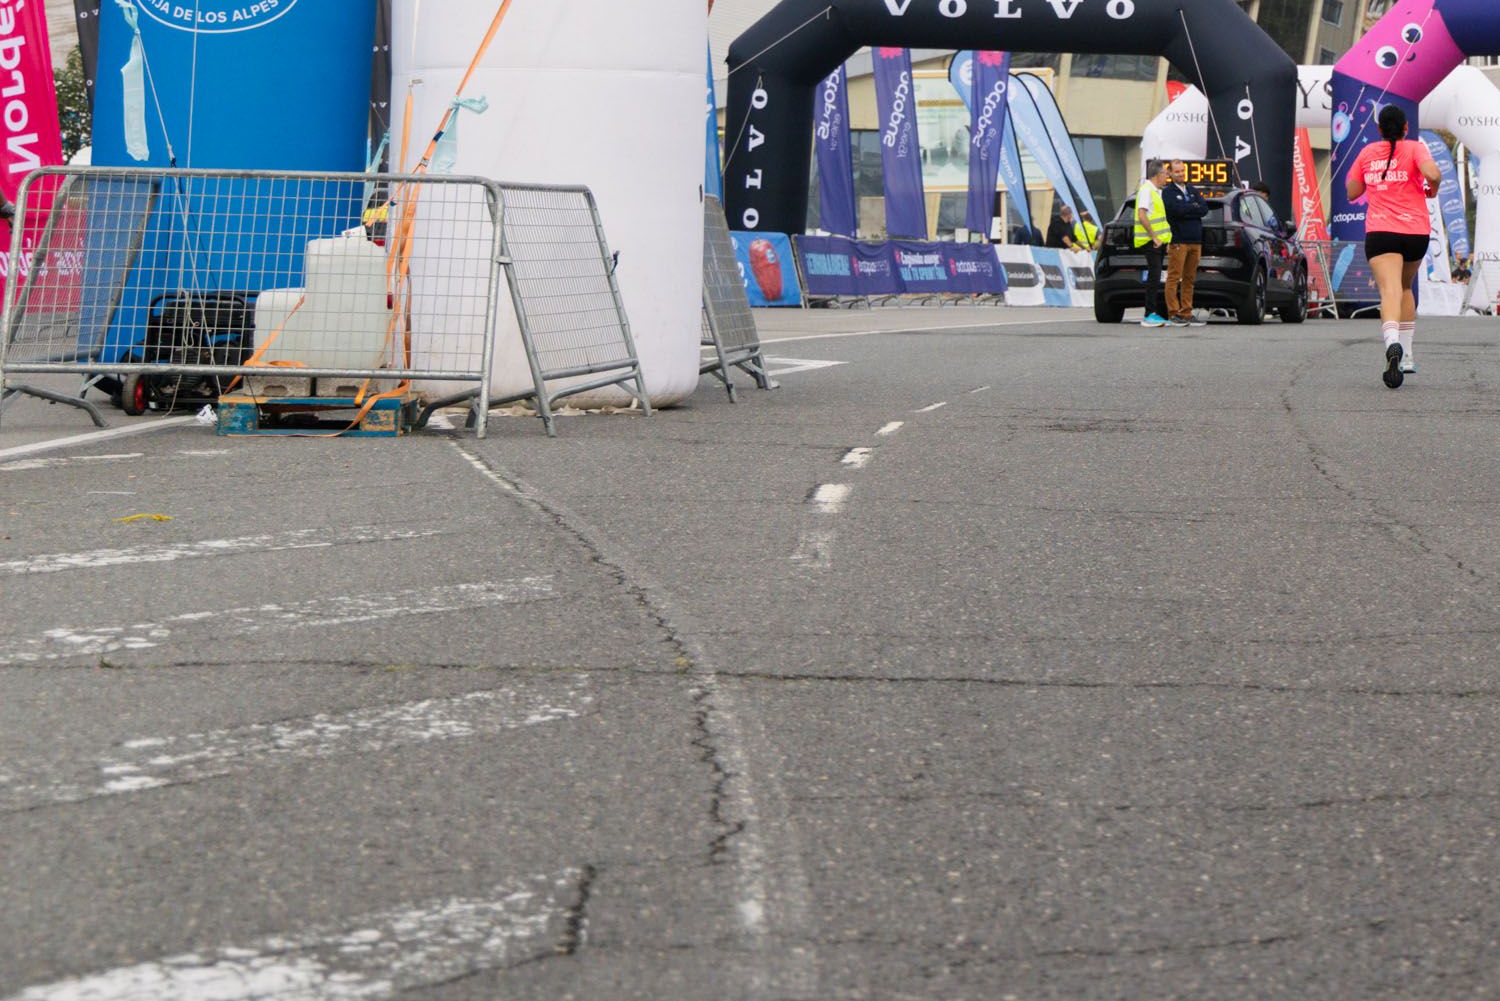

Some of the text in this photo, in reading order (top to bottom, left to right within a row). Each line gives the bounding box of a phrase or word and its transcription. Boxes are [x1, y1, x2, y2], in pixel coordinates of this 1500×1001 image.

[173, 5, 194, 22] DE
[197, 11, 227, 23] LOS
[1333, 212, 1365, 225] octopus
